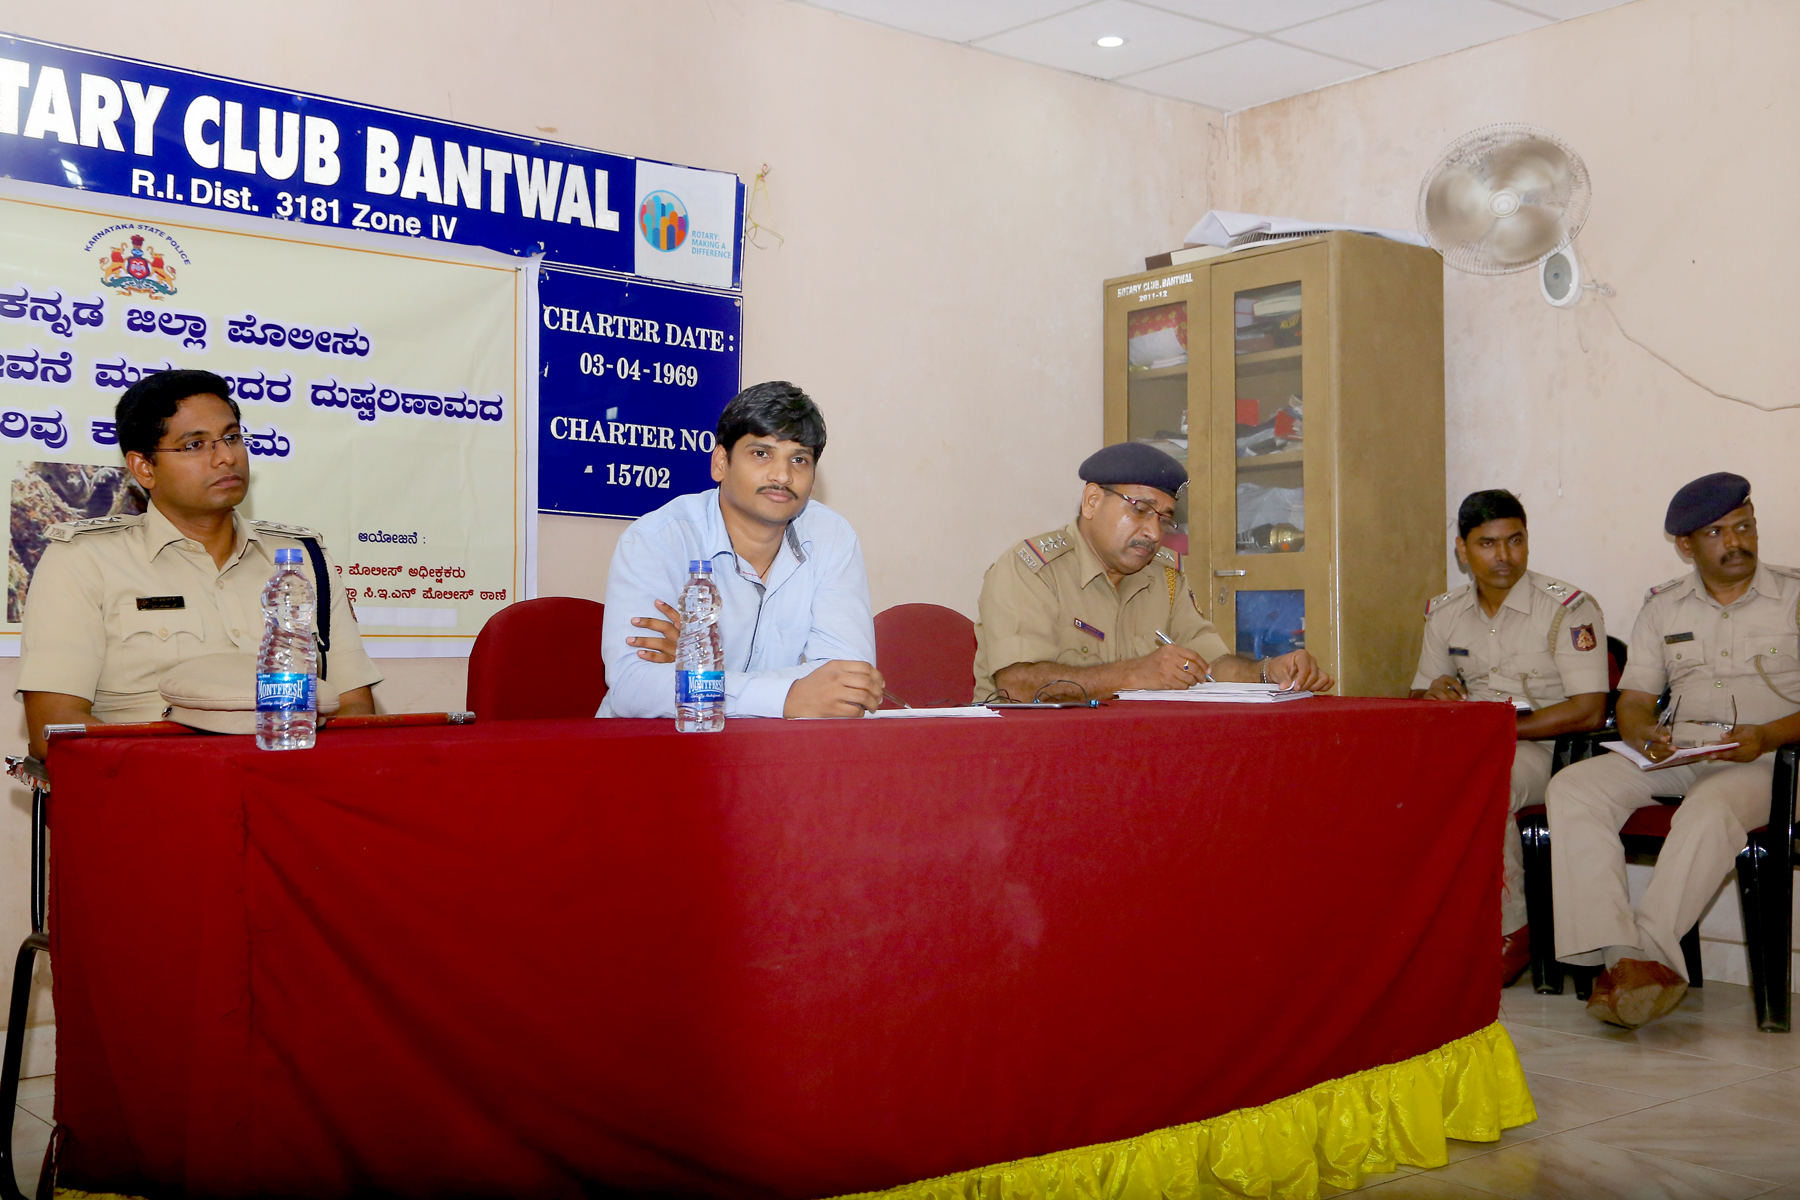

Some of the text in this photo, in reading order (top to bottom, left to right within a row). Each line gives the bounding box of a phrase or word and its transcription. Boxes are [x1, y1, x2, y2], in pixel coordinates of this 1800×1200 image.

[183, 95, 341, 187] CLUB
[365, 126, 620, 232] BANTWAL
[276, 192, 340, 224] 3181
[352, 203, 421, 235] Zone
[432, 214, 457, 240] IV
[84, 223, 191, 265] KARNATAKA STATE POLICE
[691, 238, 720, 249] MAKING
[691, 247, 731, 258] DIFFERENCE
[1117, 283, 1141, 298] ROTARY
[1139, 290, 1168, 302] 2011-12
[126, 308, 208, 350] ಜಿಲ್ಲಾ
[227, 314, 370, 357] ಪೊಲೀಸು
[543, 304, 661, 344] CHARTER
[580, 352, 698, 388] 03-04-1969
[550, 416, 676, 450] CHARTER
[606, 463, 670, 489] 15702
[408, 565, 466, 584] ಅಧೀಕ್ಷಕರು
[480, 589, 507, 601] ಠಾಣೆ
